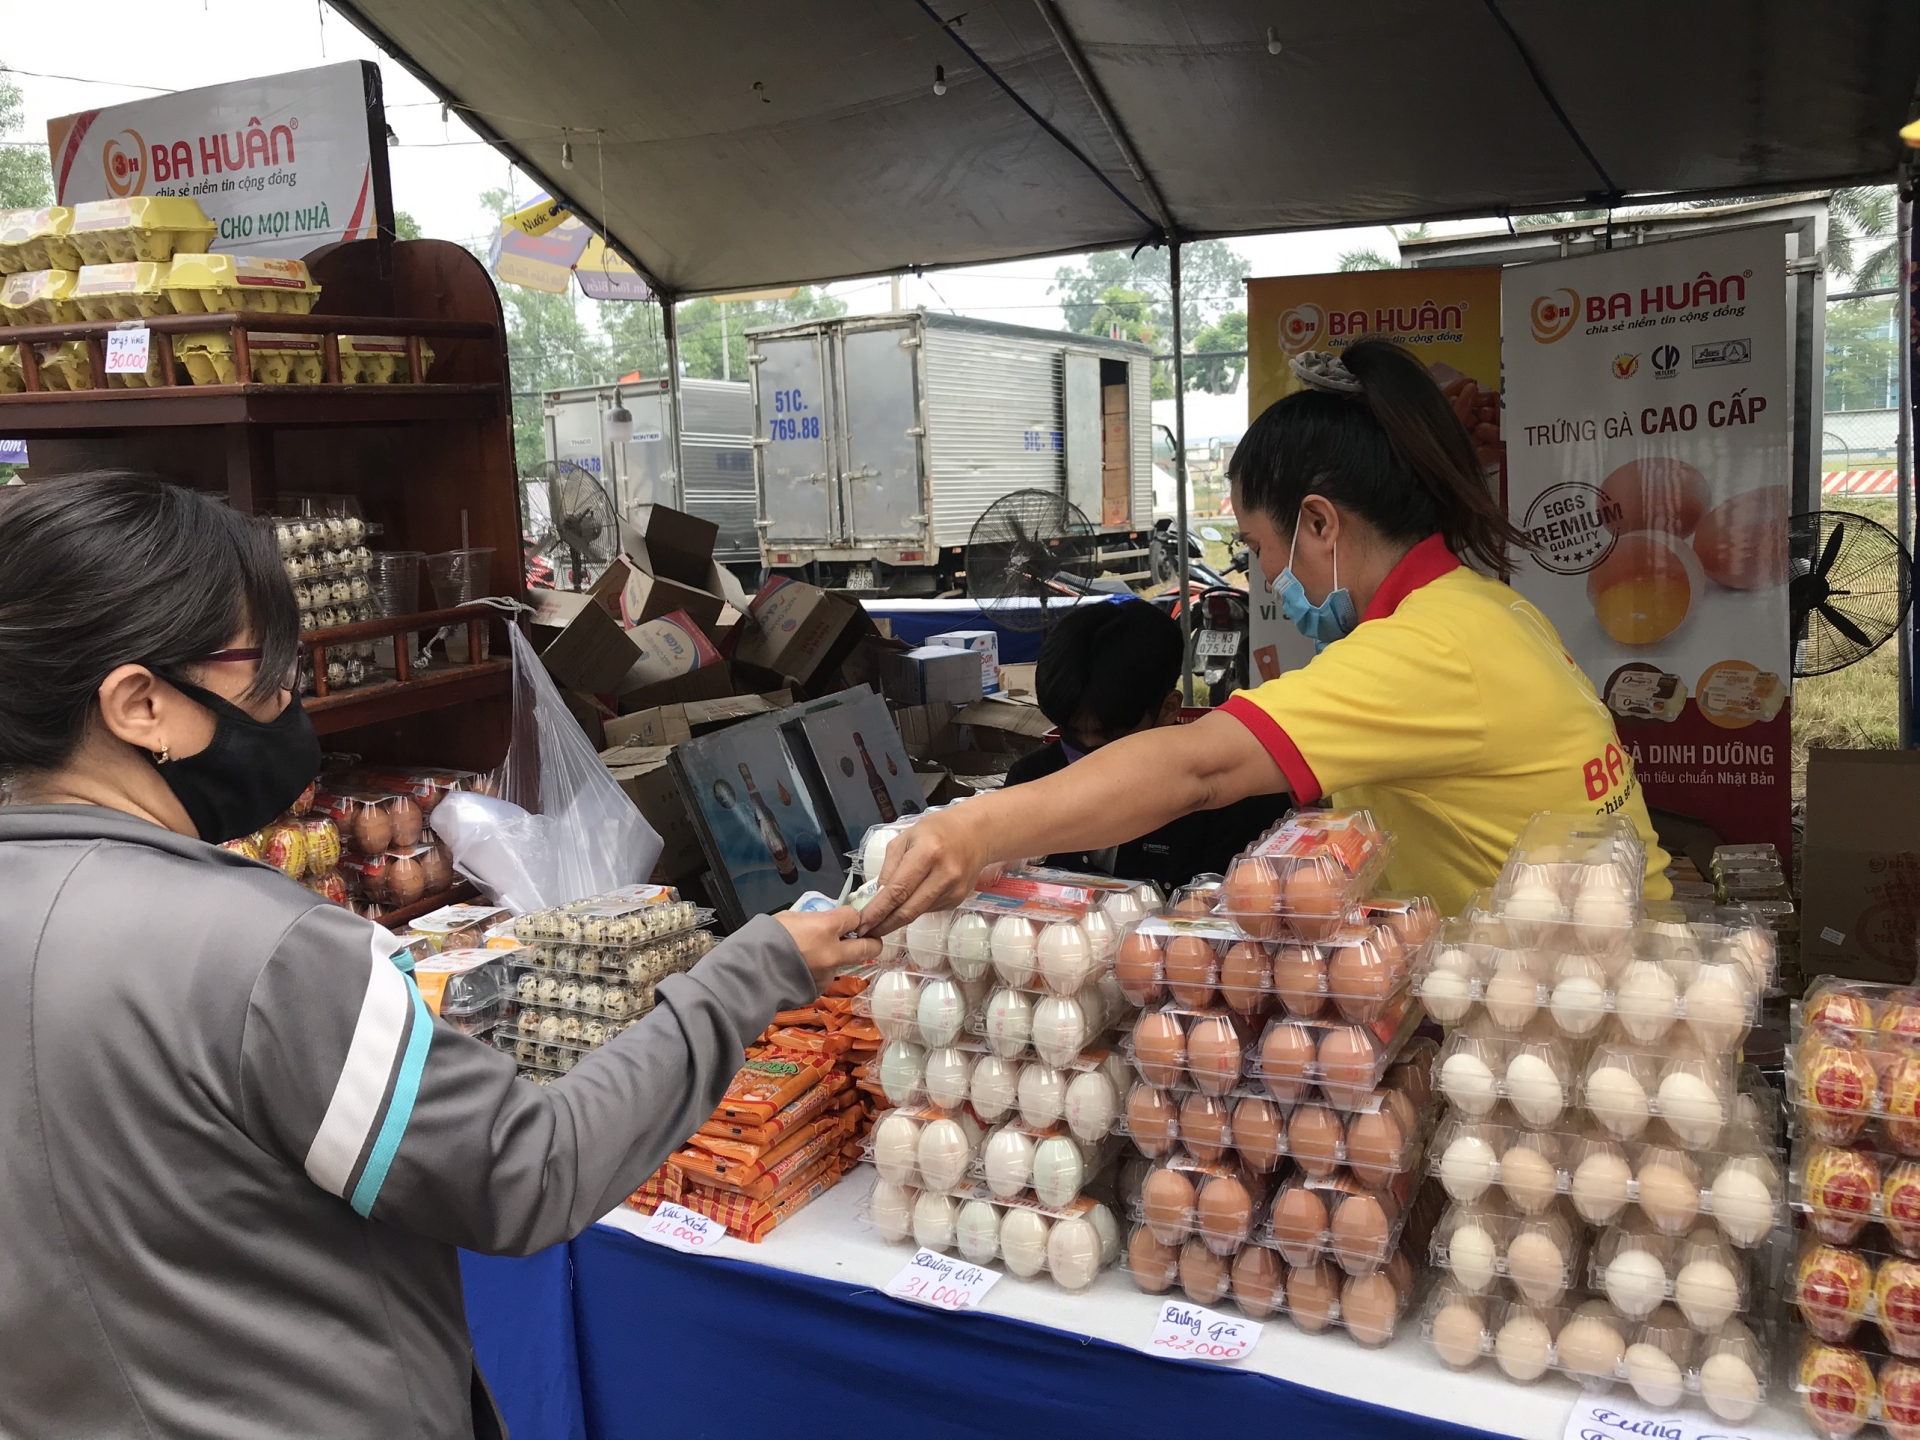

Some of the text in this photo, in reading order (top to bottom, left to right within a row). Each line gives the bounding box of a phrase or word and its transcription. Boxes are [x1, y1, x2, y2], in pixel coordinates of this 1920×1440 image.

[151, 116, 296, 183] BA HUÂN
[192, 178, 218, 195] niềm
[221, 178, 235, 192] tin
[238, 176, 265, 193] cộng
[268, 171, 297, 188] đồng
[221, 201, 331, 240] CHO MỌI NHÀ
[1586, 271, 1745, 323] BA HUÂN
[1329, 300, 1462, 336] BA HUÂN
[1585, 304, 1746, 336] chia sẻ niềm tin cộng đồng
[1408, 333, 1433, 345] cộng
[1437, 330, 1464, 343] đồng
[770, 417, 820, 442] 769.88
[1524, 388, 1768, 448] TRỨNG GÀ CAO CẤP
[1544, 494, 1587, 520] EGGS
[1524, 501, 1625, 547] PREMIUM
[1549, 530, 1600, 553] QUALITY
[1260, 601, 1276, 621] VÌ
[1205, 632, 1234, 643] 59-N3
[1650, 745, 1697, 765] DINH
[1702, 741, 1774, 766] DƯỠNG
[1583, 743, 1625, 801] BA
[1654, 770, 1676, 784] tiêu
[1679, 769, 1714, 784] chuẩn
[1718, 771, 1746, 787] Nhật
[1751, 771, 1775, 785] Bản
[652, 1221, 704, 1245] 12.000
[896, 1277, 971, 1306] 31.000
[1154, 1335, 1242, 1357] 22.000
